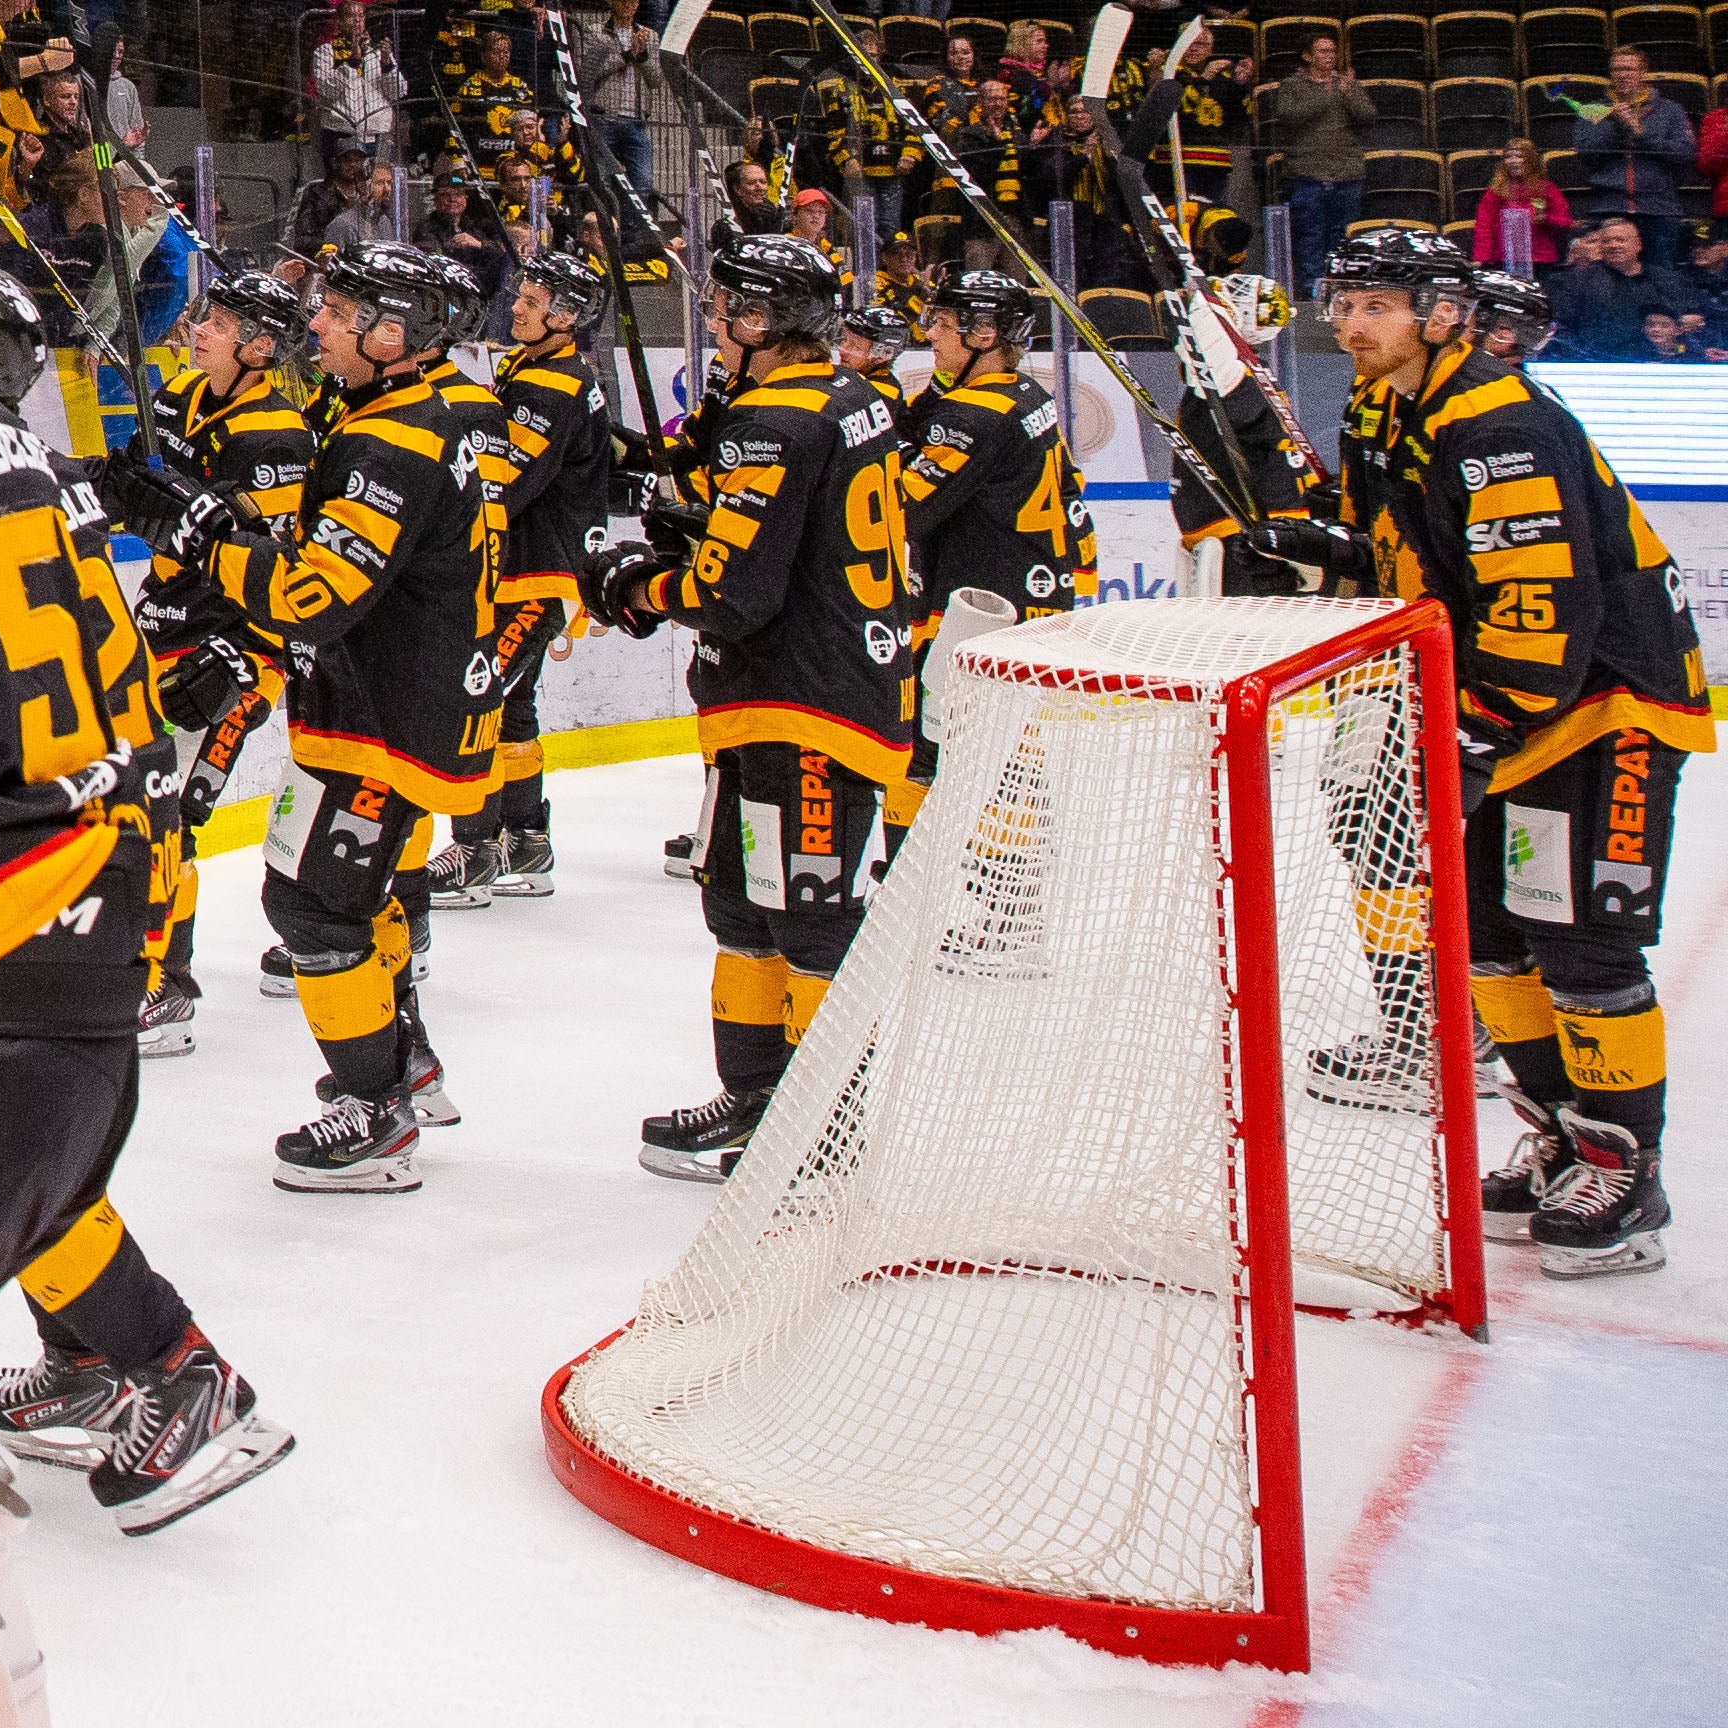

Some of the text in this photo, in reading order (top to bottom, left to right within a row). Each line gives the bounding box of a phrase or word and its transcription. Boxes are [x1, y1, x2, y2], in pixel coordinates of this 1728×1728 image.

[546, 10, 587, 127] CCM
[892, 98, 987, 198] CCM
[1141, 195, 1206, 277] CCM
[377, 295, 413, 310] CCM
[1488, 582, 1555, 632] 25
[209, 635, 254, 683] CCM
